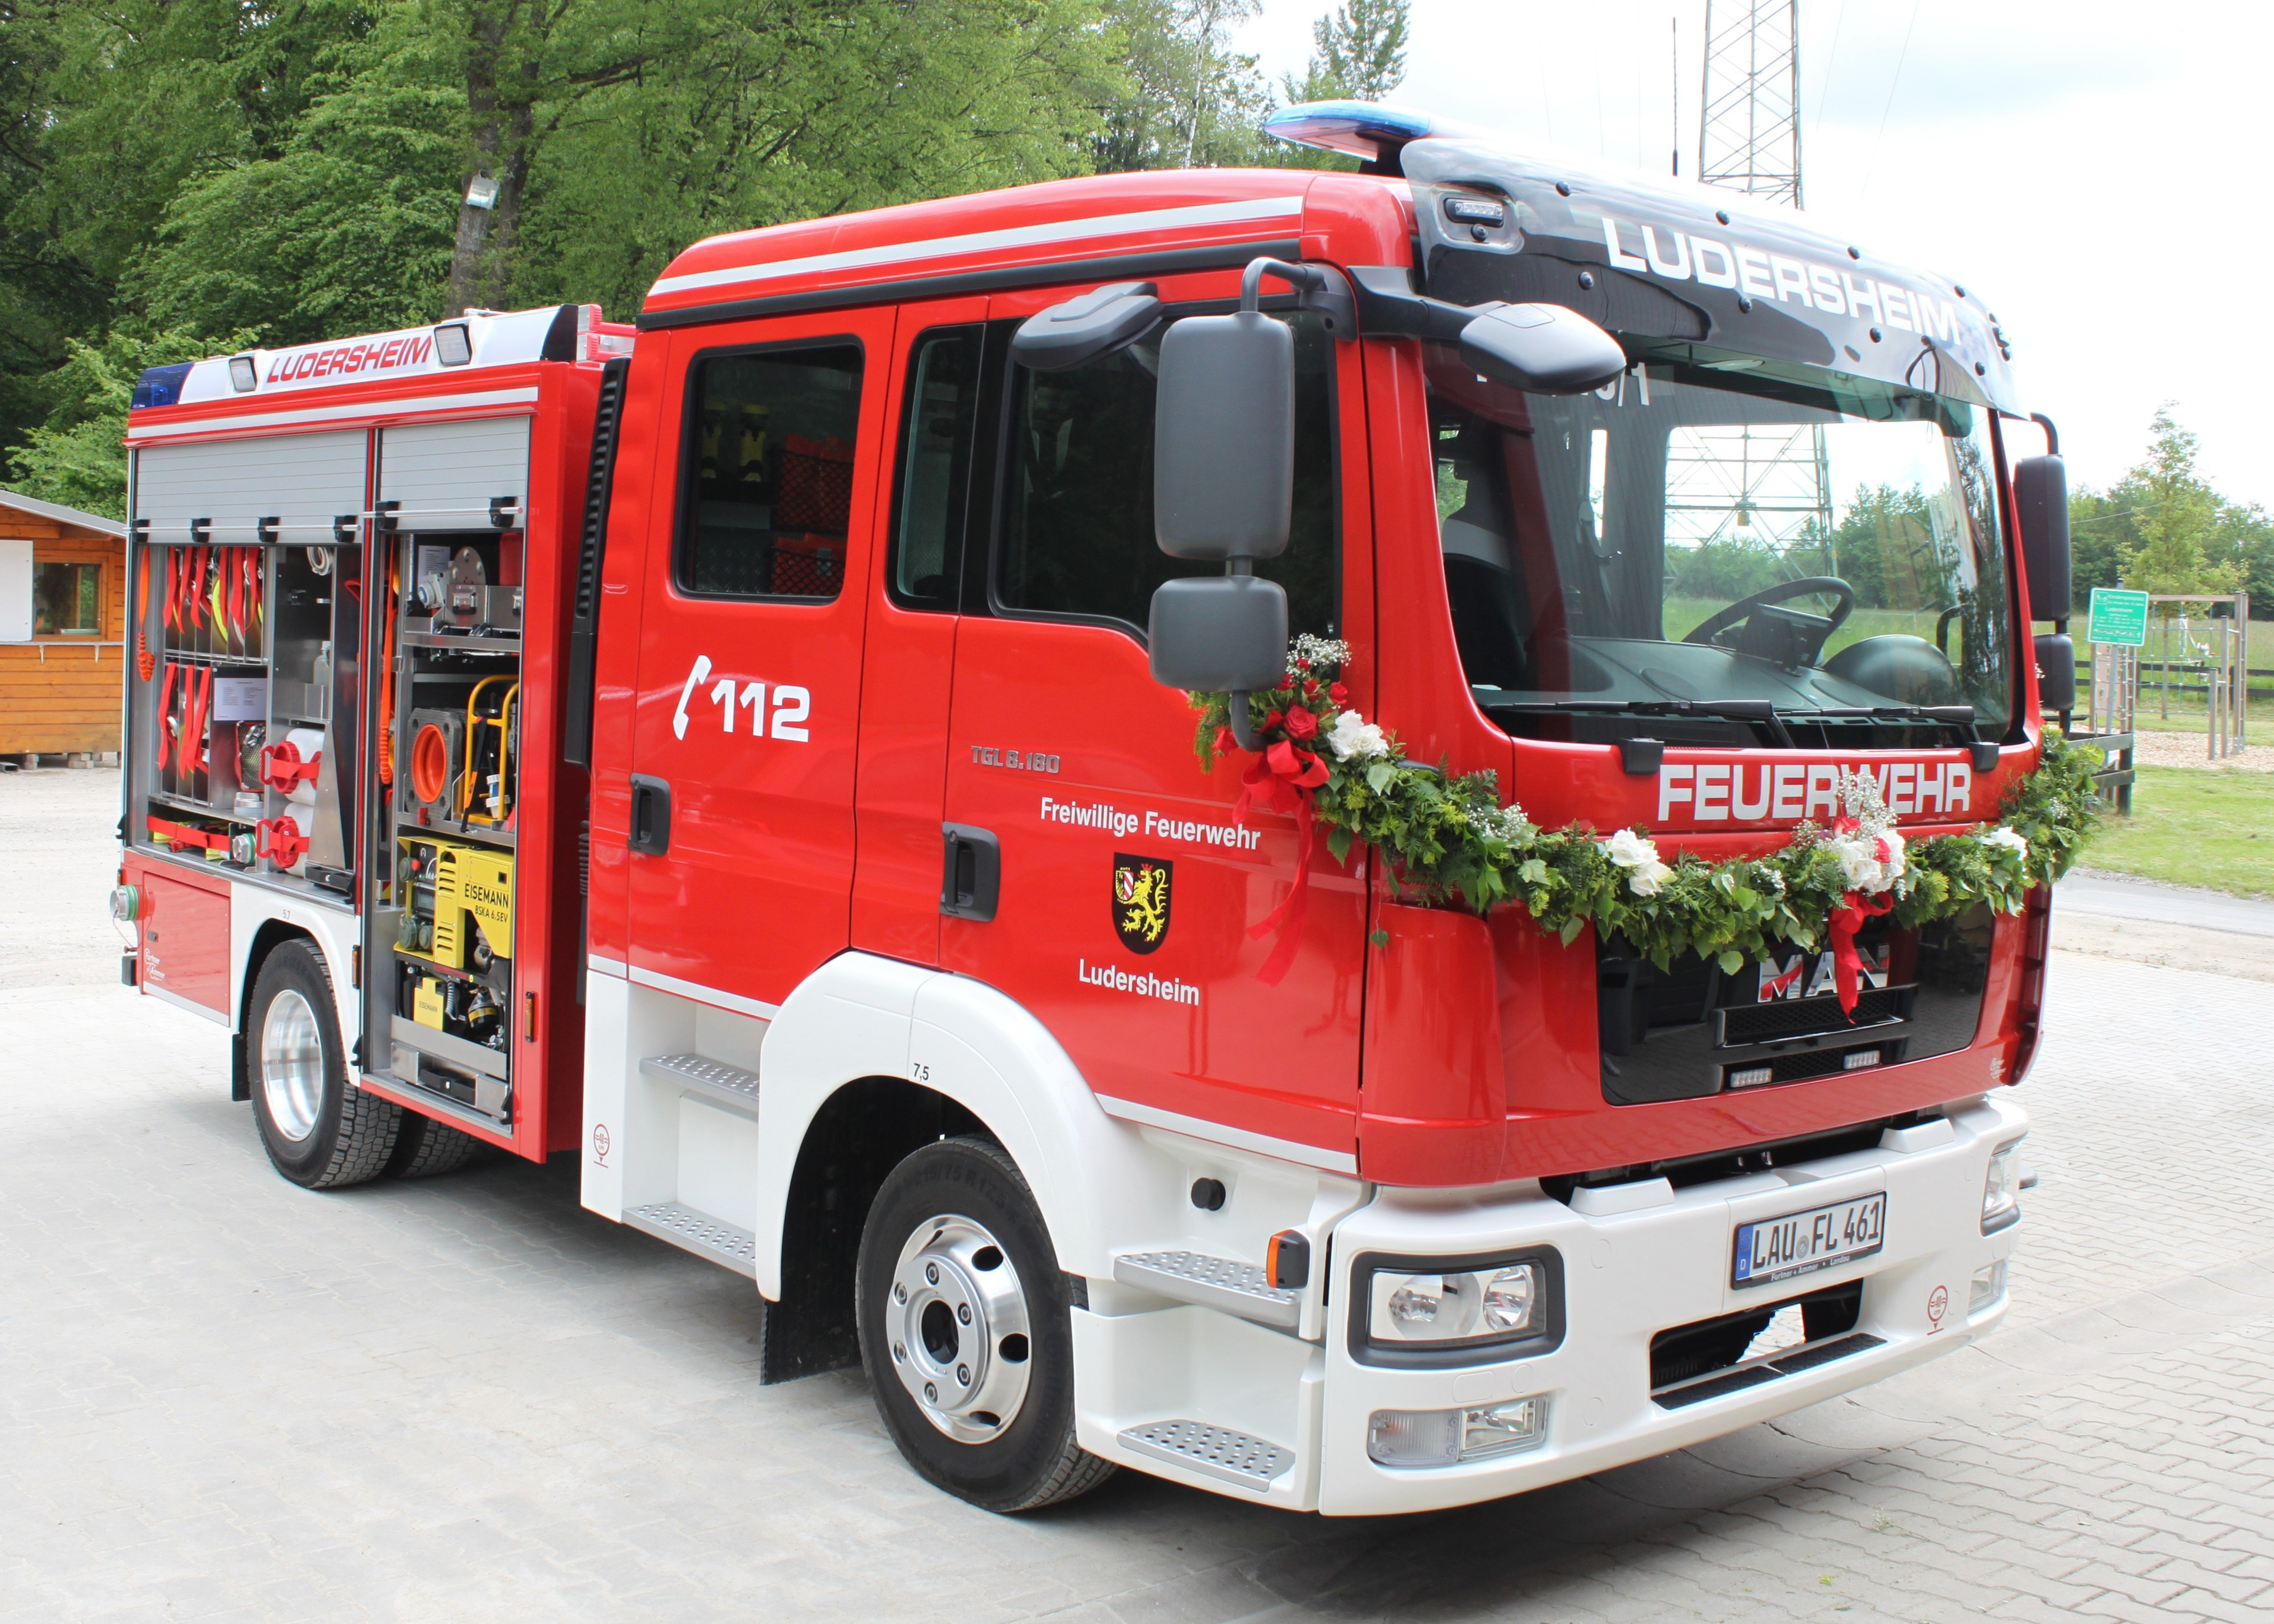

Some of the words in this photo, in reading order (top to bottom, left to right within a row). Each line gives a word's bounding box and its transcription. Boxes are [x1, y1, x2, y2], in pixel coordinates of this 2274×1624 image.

[1601, 217, 1961, 346] LUDERSHEIM
[267, 335, 432, 383] LUDERSHEIM
[711, 679, 810, 742] 112
[971, 745, 1004, 767] TGL
[1005, 750, 1060, 774] 8.180
[1041, 797, 1138, 837] Freiwillige
[1145, 811, 1261, 850] Feuerwehr
[465, 883, 509, 909] EISEMANN
[475, 905, 490, 918] BSKA
[1079, 958, 1200, 1006] Ludersheim
[1758, 943, 1889, 1002] MAN
[914, 1062, 929, 1082] 7,5
[1752, 1221, 1797, 1269] LAU
[1811, 1213, 1837, 1255] FL
[1843, 1201, 1880, 1245] 461
[1740, 1259, 1746, 1270] D
[1771, 1268, 1793, 1282] Furtner
[1798, 1263, 1819, 1275] Ammer
[1830, 1254, 1850, 1266] Landau
